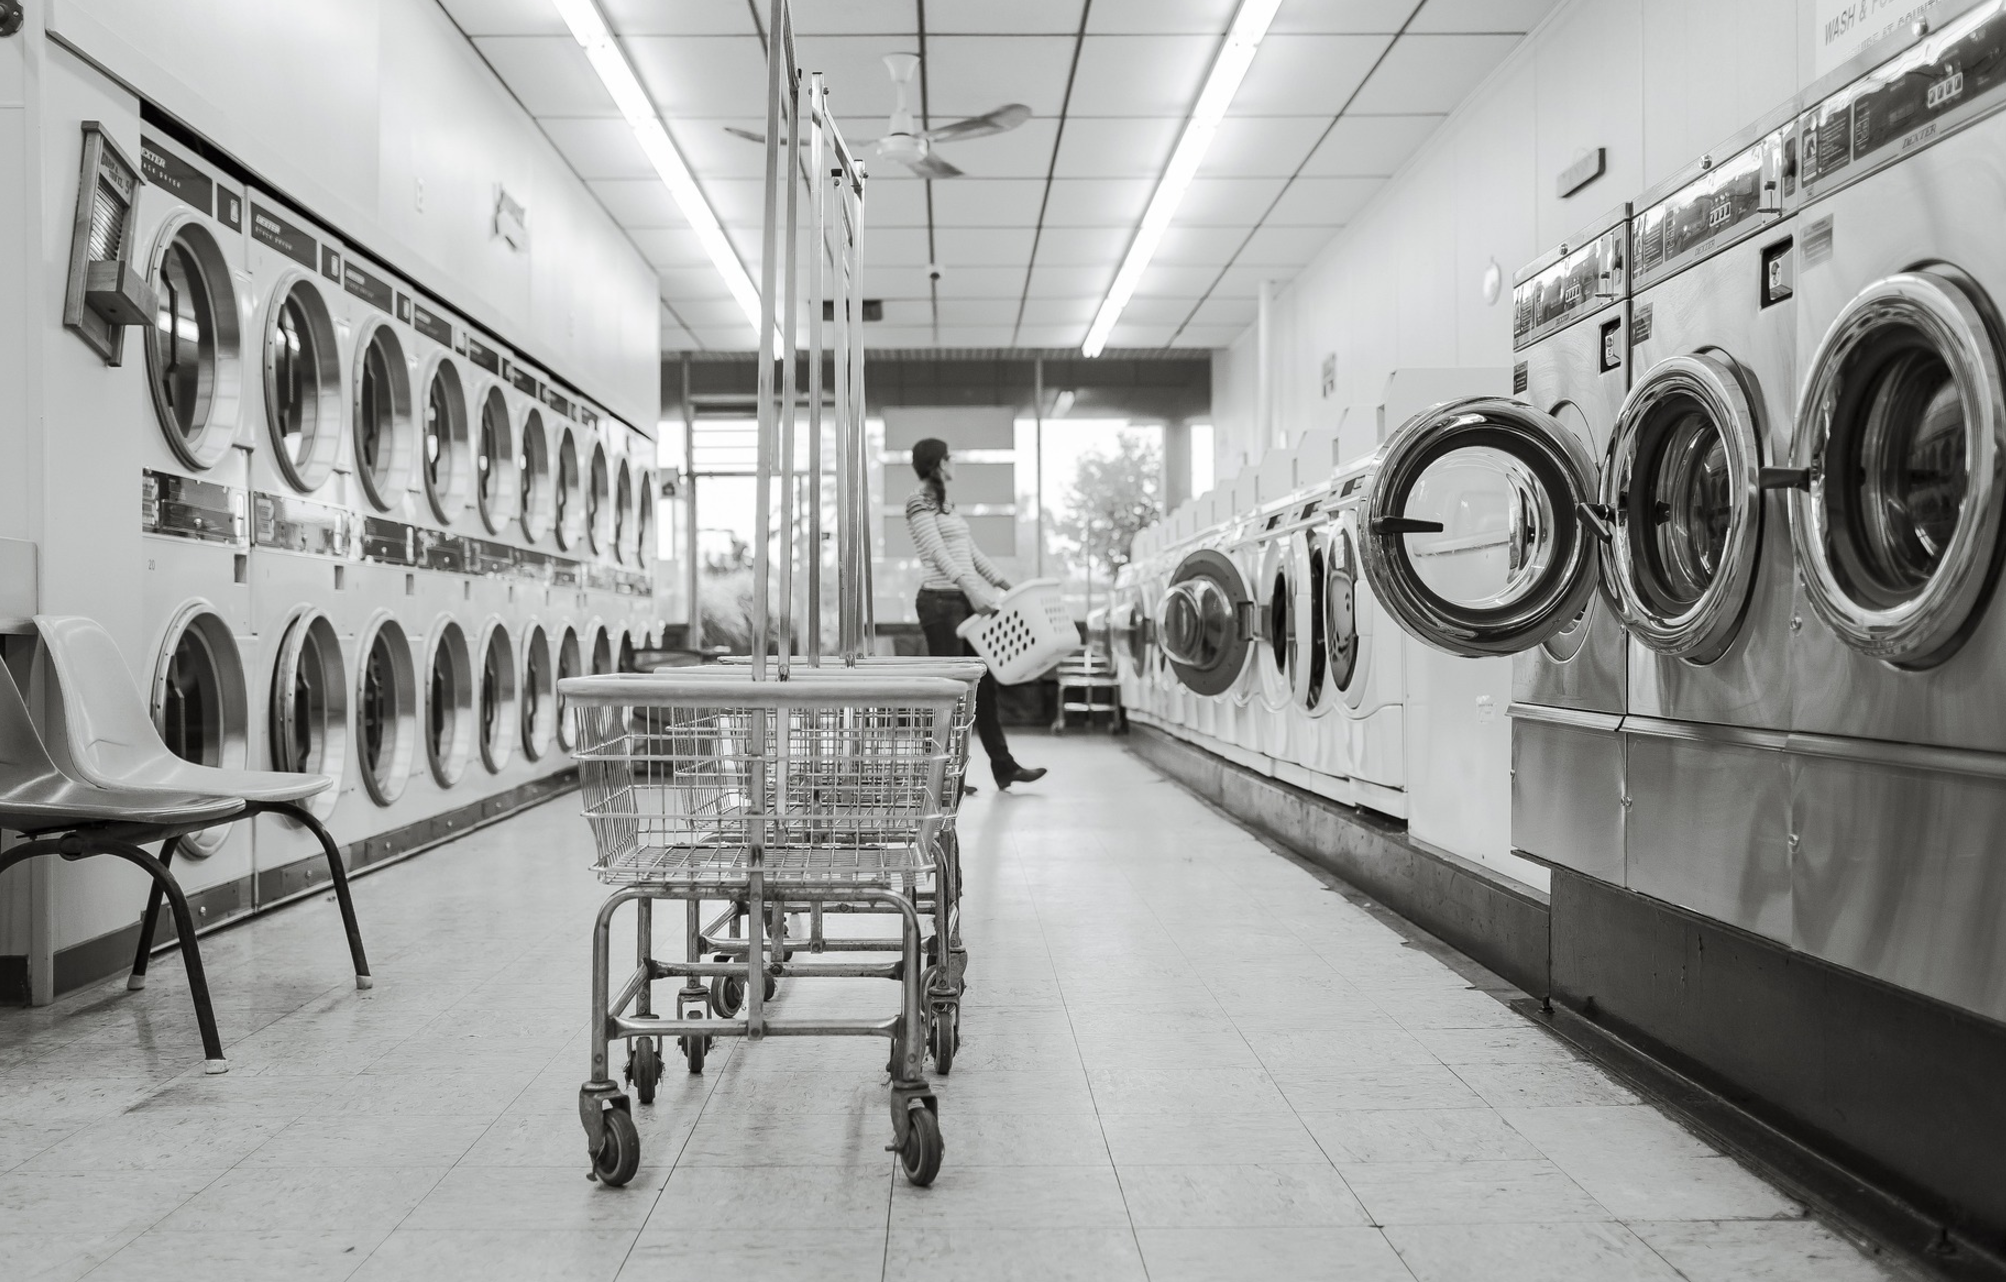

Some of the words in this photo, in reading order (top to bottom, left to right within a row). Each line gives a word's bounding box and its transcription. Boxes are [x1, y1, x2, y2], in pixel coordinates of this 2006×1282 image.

[1824, 4, 1857, 46] WASH
[1858, 0, 1868, 22] &
[1901, 123, 1937, 149] DEXTER
[141, 146, 166, 168] EXTER
[147, 558, 156, 571] 20
